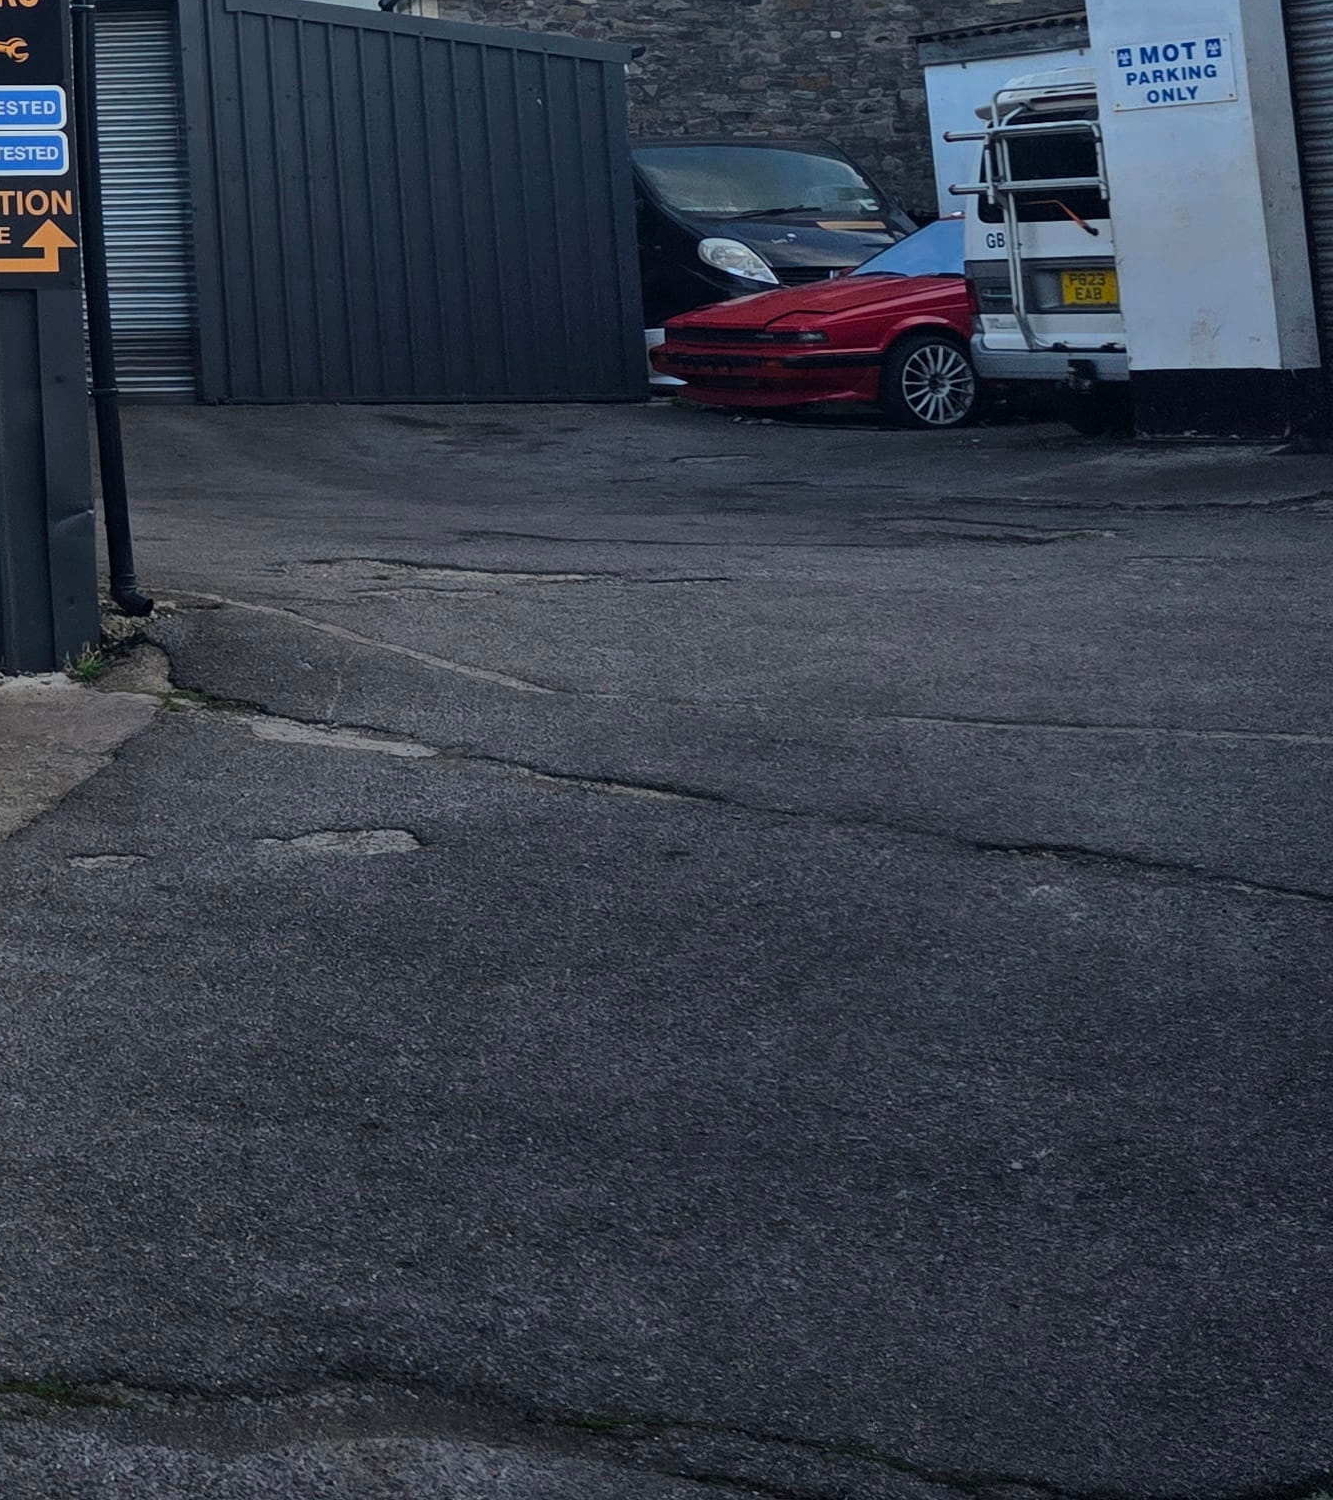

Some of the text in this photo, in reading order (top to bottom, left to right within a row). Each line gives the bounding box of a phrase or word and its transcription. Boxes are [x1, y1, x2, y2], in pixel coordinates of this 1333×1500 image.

[1139, 41, 1196, 64] MOT
[1126, 64, 1217, 86] PARKING
[1147, 86, 1199, 104] ONLY
[986, 232, 1006, 249] GB
[1075, 287, 1102, 301] EAB
